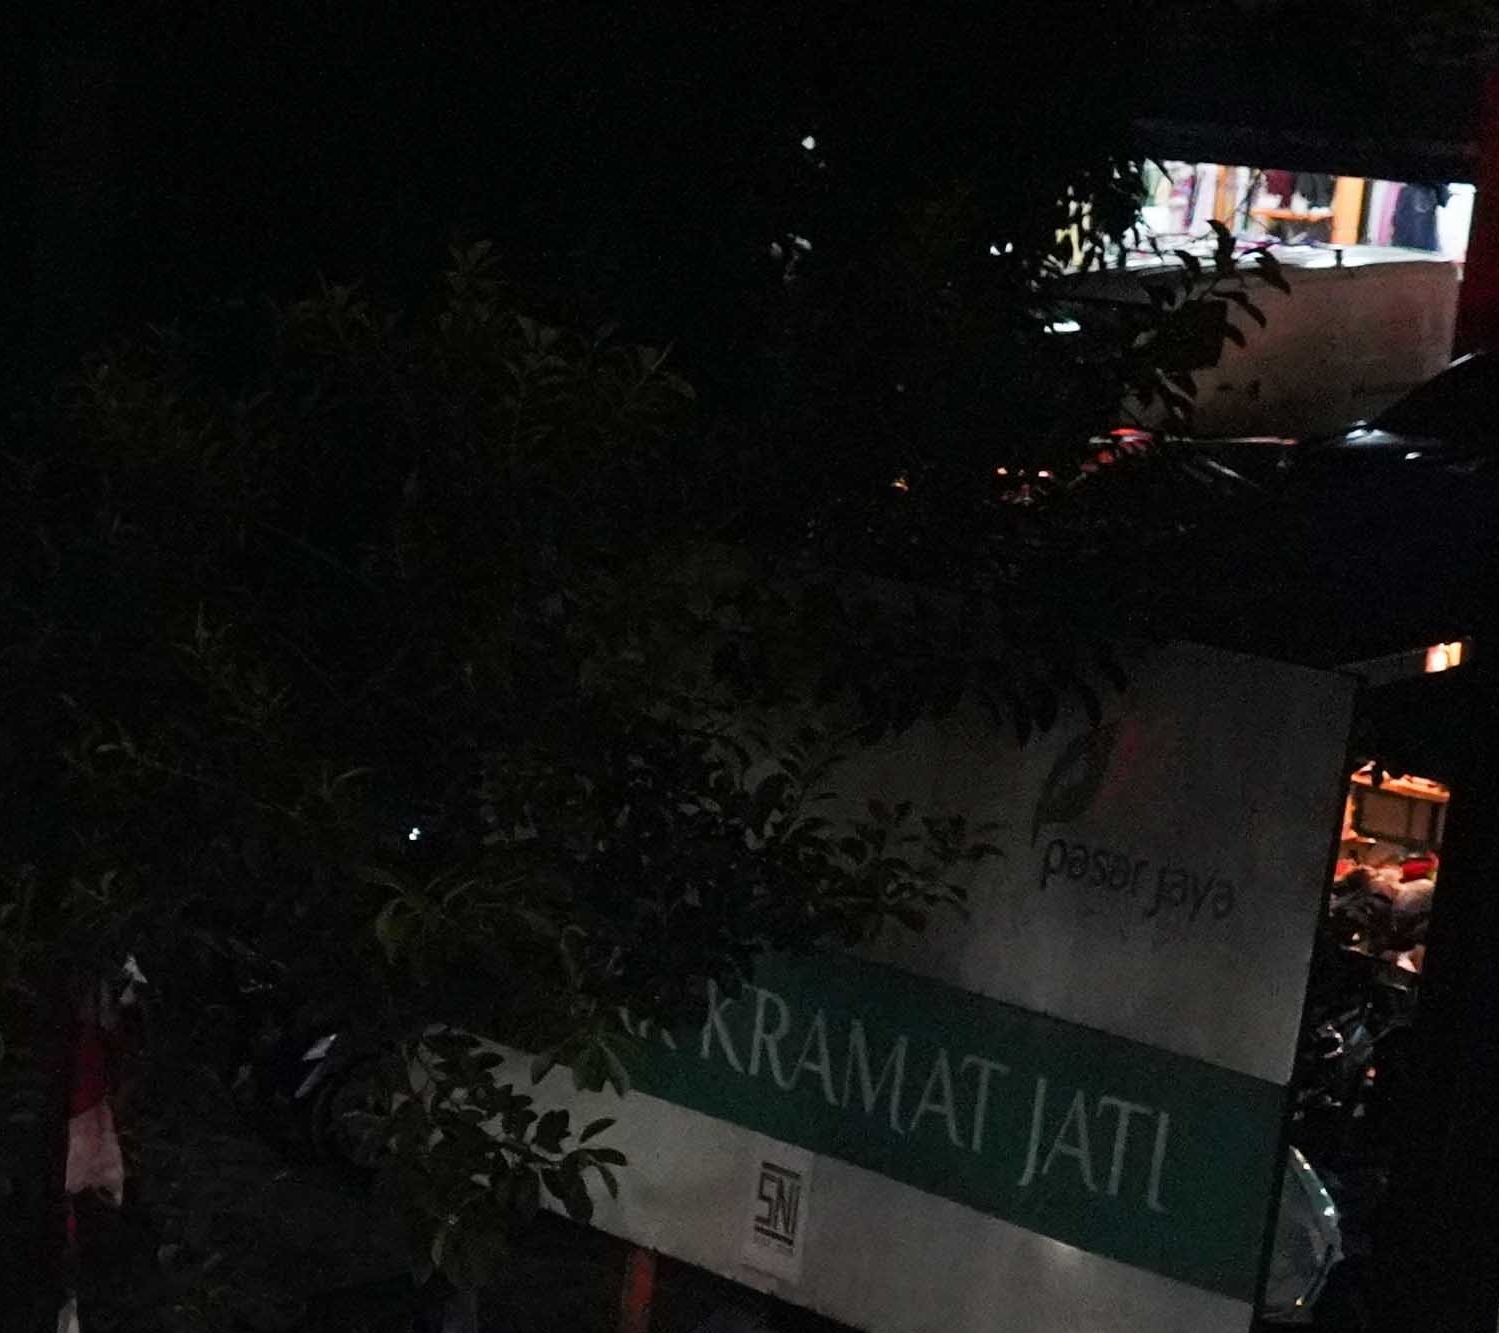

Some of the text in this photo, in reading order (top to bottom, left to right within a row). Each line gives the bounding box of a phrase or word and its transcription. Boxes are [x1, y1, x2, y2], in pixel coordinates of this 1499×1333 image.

[1040, 838, 1237, 921] pasar jaya
[700, 976, 1173, 1214] KRAMAT JATI
